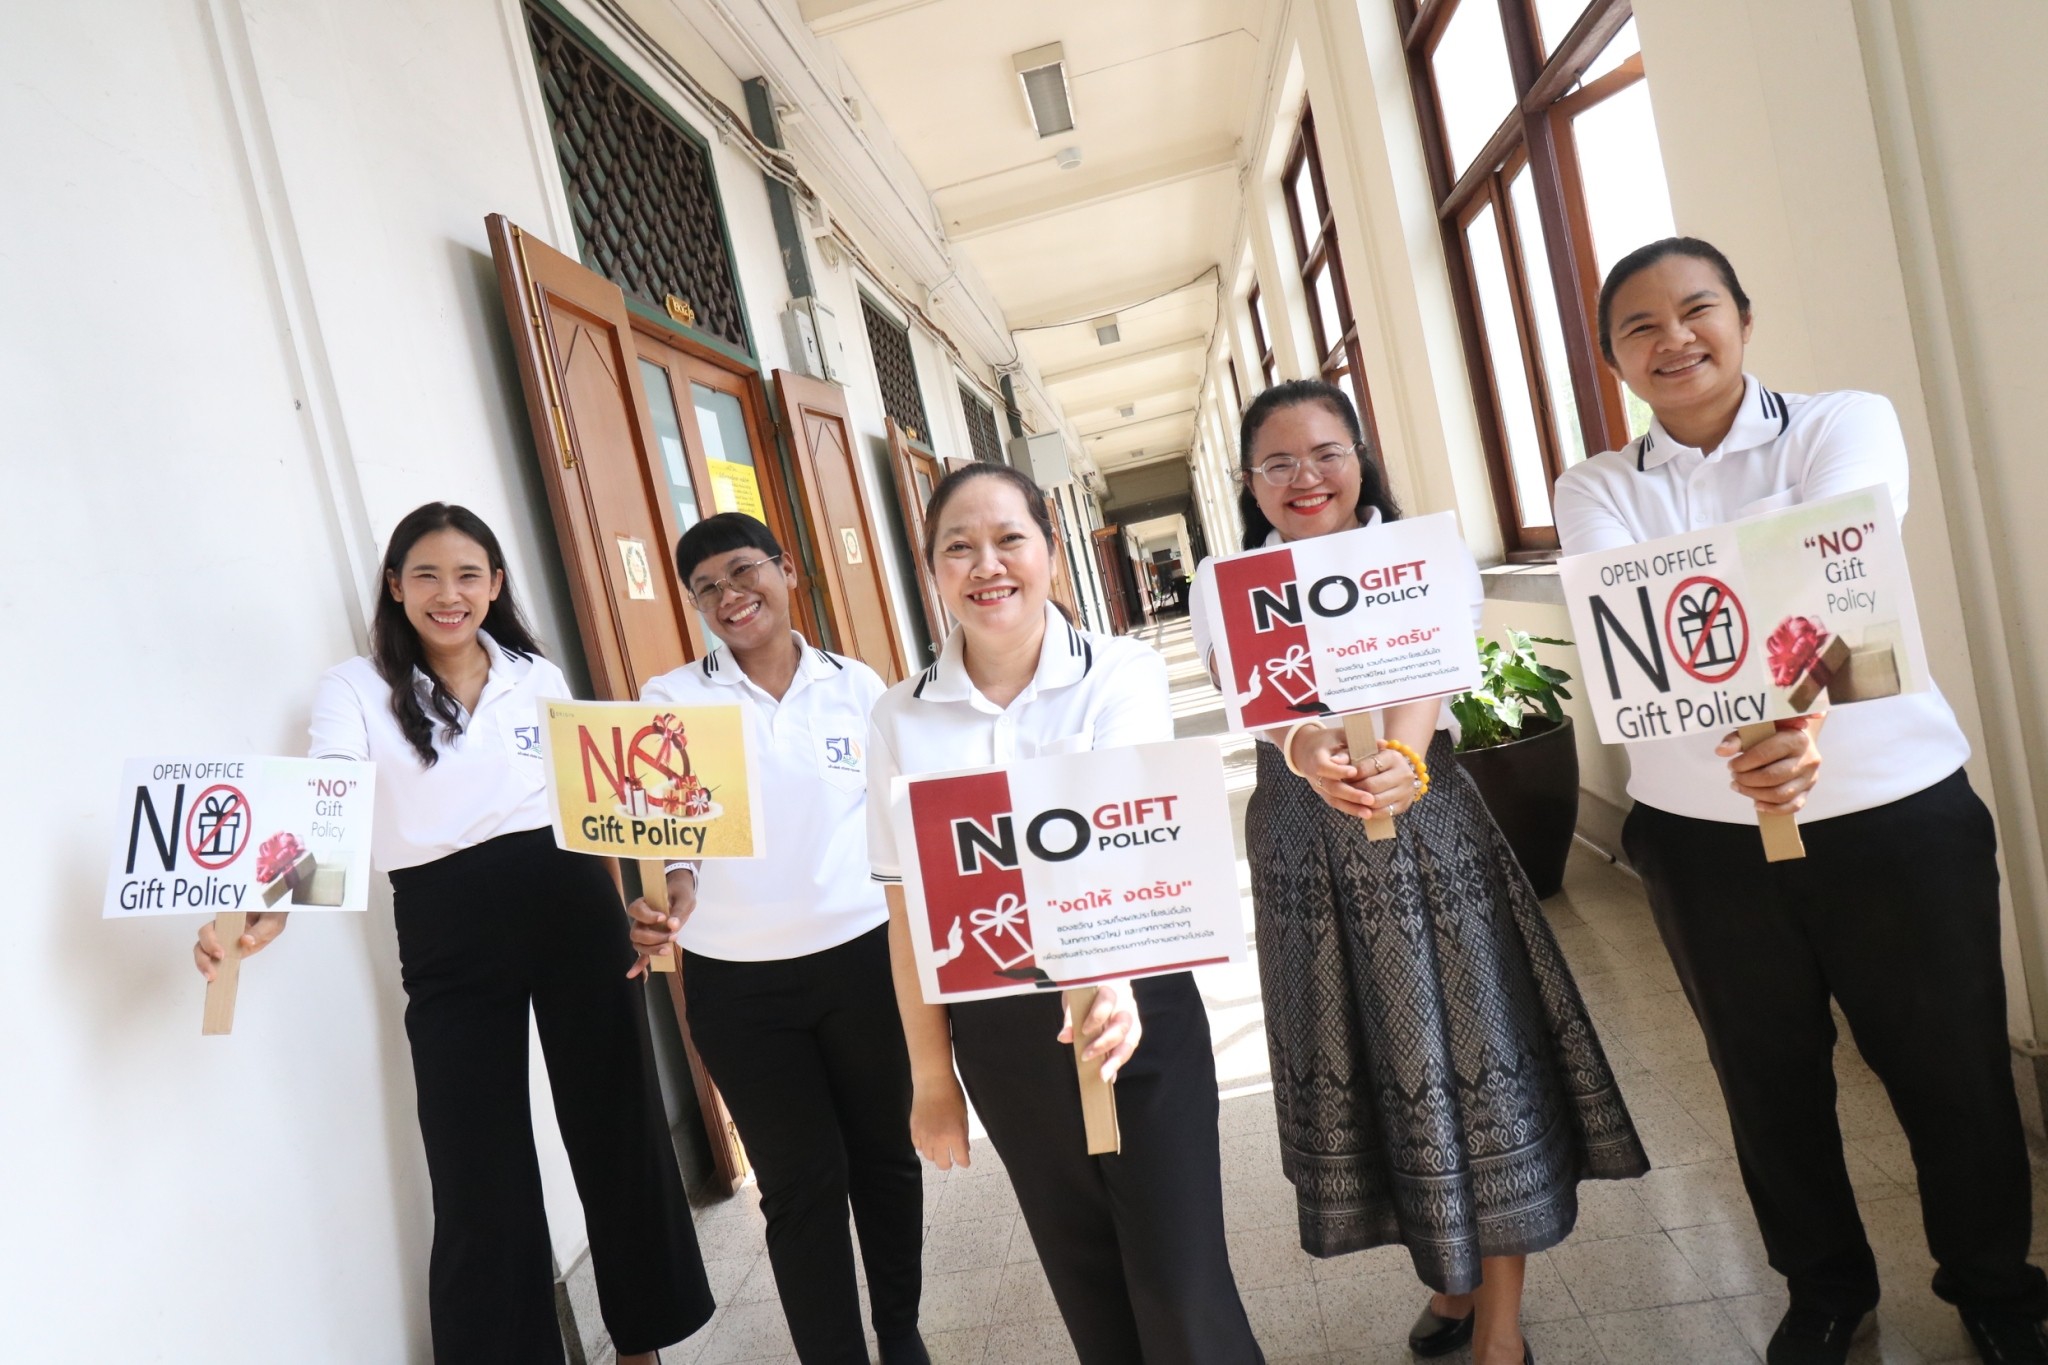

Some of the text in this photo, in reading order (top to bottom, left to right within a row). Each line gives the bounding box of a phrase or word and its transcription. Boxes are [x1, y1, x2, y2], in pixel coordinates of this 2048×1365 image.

[1600, 543, 1717, 587] OPEN OFFICE
[1824, 557, 1867, 584] Gift
[1252, 560, 1427, 631] NO GIFT
[1365, 584, 1430, 607] POLICY
[1827, 588, 1876, 614] Policy
[1616, 691, 1766, 739] Gift Policy
[514, 726, 540, 750] 51
[826, 737, 851, 763] 51
[153, 762, 245, 780] OPEN OFFICE
[315, 800, 343, 817] Gift
[311, 821, 345, 842] Policy
[581, 815, 707, 854] Gift Policy
[954, 795, 1178, 873] NO GIFT
[1099, 826, 1181, 851] POLICY
[120, 876, 247, 910] Gift Policy
